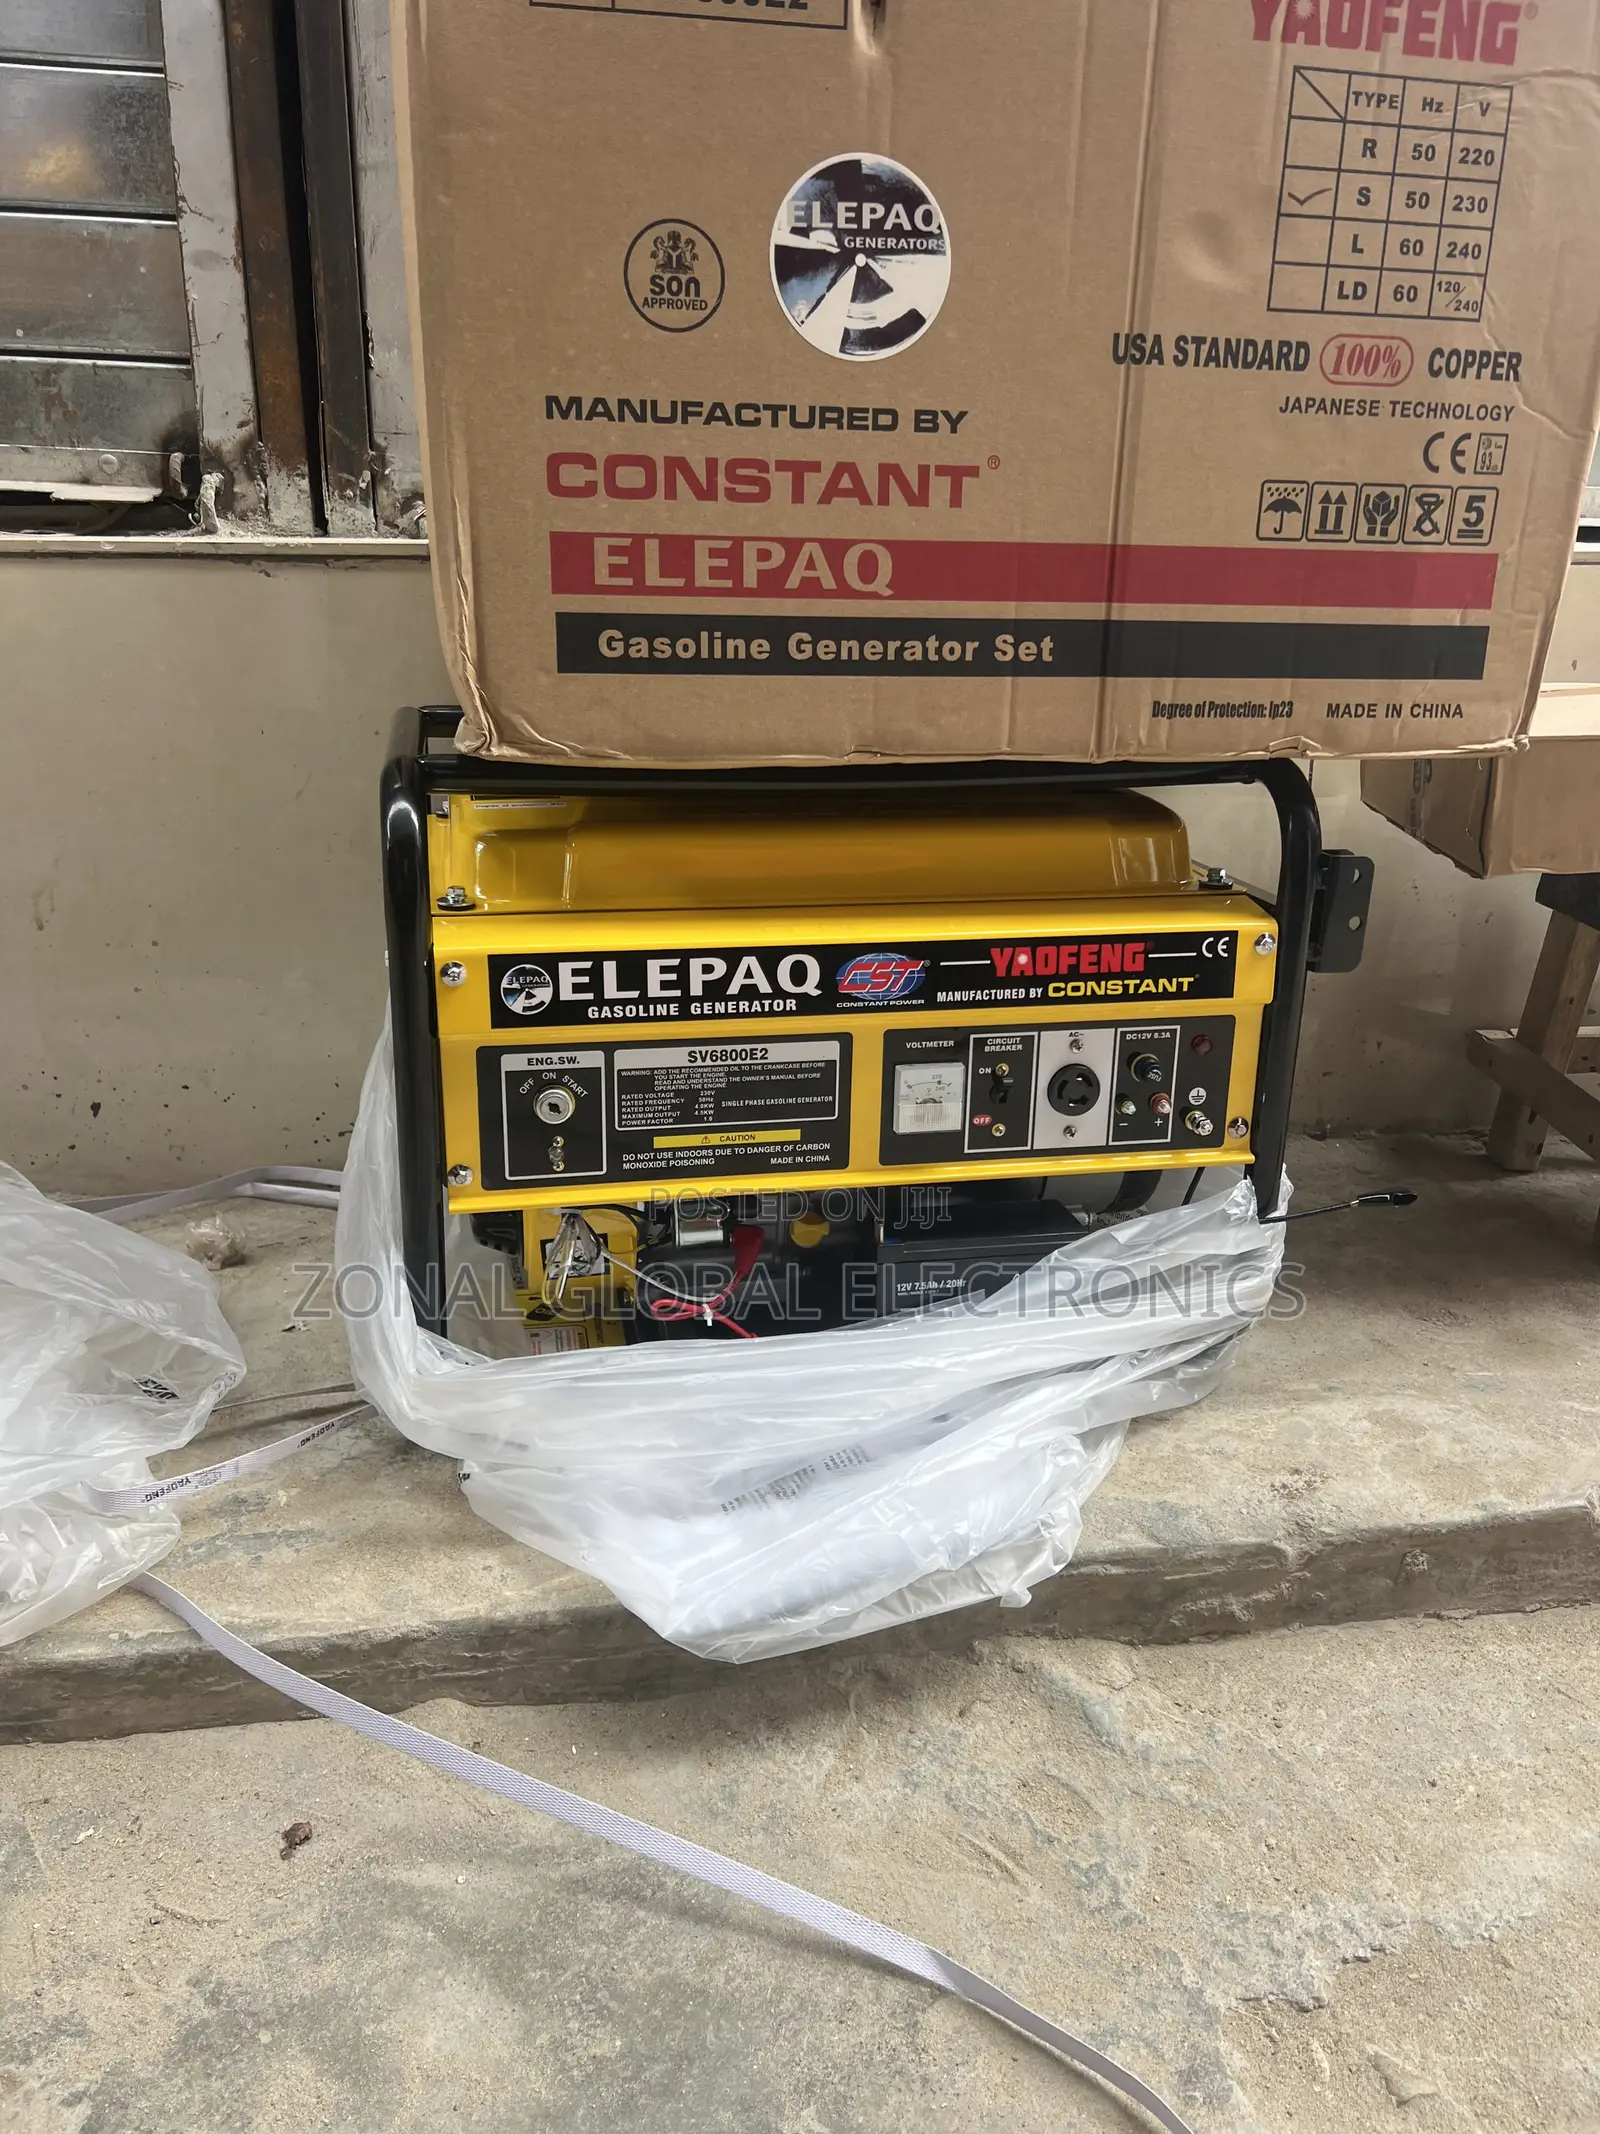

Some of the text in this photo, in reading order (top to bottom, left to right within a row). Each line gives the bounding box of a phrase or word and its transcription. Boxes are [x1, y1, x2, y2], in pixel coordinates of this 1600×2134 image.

[1251, 0, 1522, 66] YAOFENG
[1351, 91, 1491, 117] TYPE Hz V
[1361, 138, 1495, 167] R 50 220
[1356, 186, 1489, 214] S 50 230
[786, 201, 943, 234] ELEPAQ
[844, 235, 947, 252] GENERATORS
[1351, 234, 1482, 260] L 60 240
[1338, 281, 1368, 301] LD
[1393, 285, 1419, 304] 60
[641, 296, 708, 312] APPROVED
[1112, 332, 1522, 382] USA STANDARD 100% COPPER
[545, 395, 969, 434] MANUFACTURED BY
[1279, 396, 1515, 423] JAPANESE TECHNOLOGY
[546, 451, 981, 509] CONSTANT
[1462, 495, 1487, 528] 5
[593, 537, 895, 597] ELEPAQ
[598, 629, 1055, 663] Gasoline Generator Set
[1152, 700, 1192, 720] Degree
[1194, 701, 1207, 718] of
[1207, 701, 1268, 719] Protection:
[1326, 703, 1464, 719] MADE IN CHINA
[990, 942, 1145, 977] YAOFENG
[507, 975, 549, 984] ELEPAQ
[558, 953, 823, 1001] ELEPAQ
[937, 977, 1194, 1003] MANUFACTURED BY CONSTANT
[587, 998, 798, 1019] GASOLINE GENERATOR
[836, 1000, 888, 1008] CONSTANT
[906, 1040, 954, 1049] VOLTMETER
[984, 1044, 1023, 1052] BREAKER
[987, 1037, 1021, 1045] CIRCUIT
[527, 1056, 580, 1066] ENG.SW.
[687, 1048, 769, 1064] SV6800E2
[542, 1071, 557, 1080] ON
[681, 1066, 729, 1074] RECOMMENDED
[978, 1067, 991, 1075] ON
[519, 1077, 535, 1095] OFF
[562, 1075, 589, 1099] START
[721, 1100, 744, 1108] SINGLE
[765, 1097, 796, 1105] GASOLINE
[973, 1117, 991, 1125] OFF
[719, 1133, 756, 1143] CAUTION
[622, 1142, 831, 1161] DO NOT USE INDOORS DUE TO DANGER OF CARBON
[770, 1155, 830, 1165] MADE IN CHINA
[622, 1158, 715, 1170] MONOXIDE POISONING
[896, 1283, 912, 1292] 12V
[914, 1281, 938, 1290] 7.5Ah
[946, 1279, 967, 1288] 20Hr
